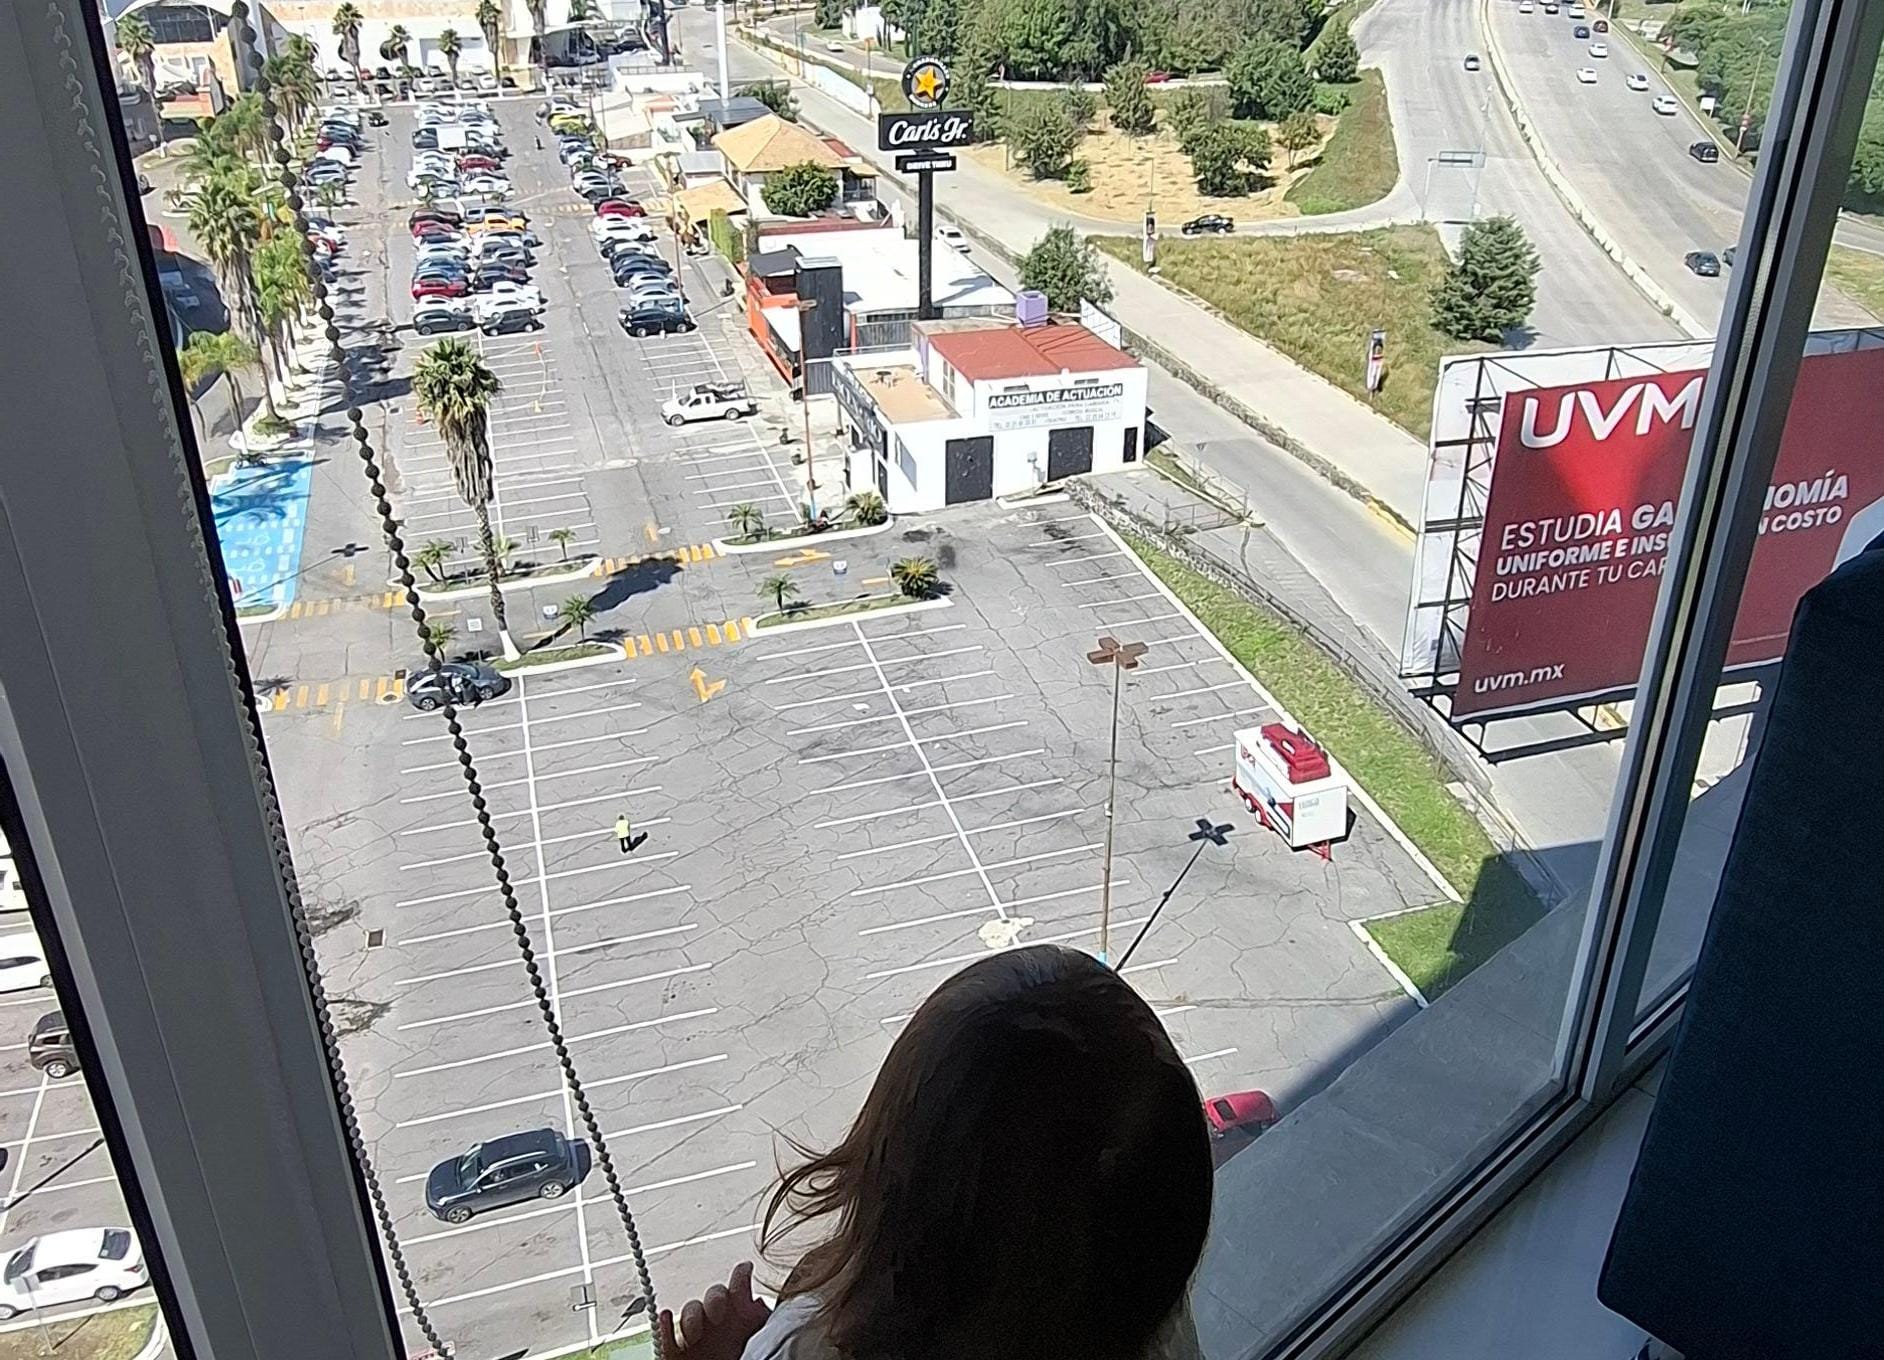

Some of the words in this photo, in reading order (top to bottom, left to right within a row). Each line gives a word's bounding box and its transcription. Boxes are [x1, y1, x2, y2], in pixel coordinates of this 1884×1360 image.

[888, 117, 941, 145] Carl's
[941, 117, 969, 143] Jr.
[989, 392, 1045, 408] ACADEMIA
[1046, 390, 1062, 403] DE
[1519, 376, 1704, 448] UVM
[1501, 507, 1623, 550] ESTUDIA
[1771, 506, 1842, 532] COSTO
[1496, 541, 1611, 576] UNIFORME
[1614, 539, 1628, 558] E
[1491, 569, 1591, 601] DURANTE
[1597, 564, 1623, 585] TU
[1474, 664, 1565, 693] uvm.mx
